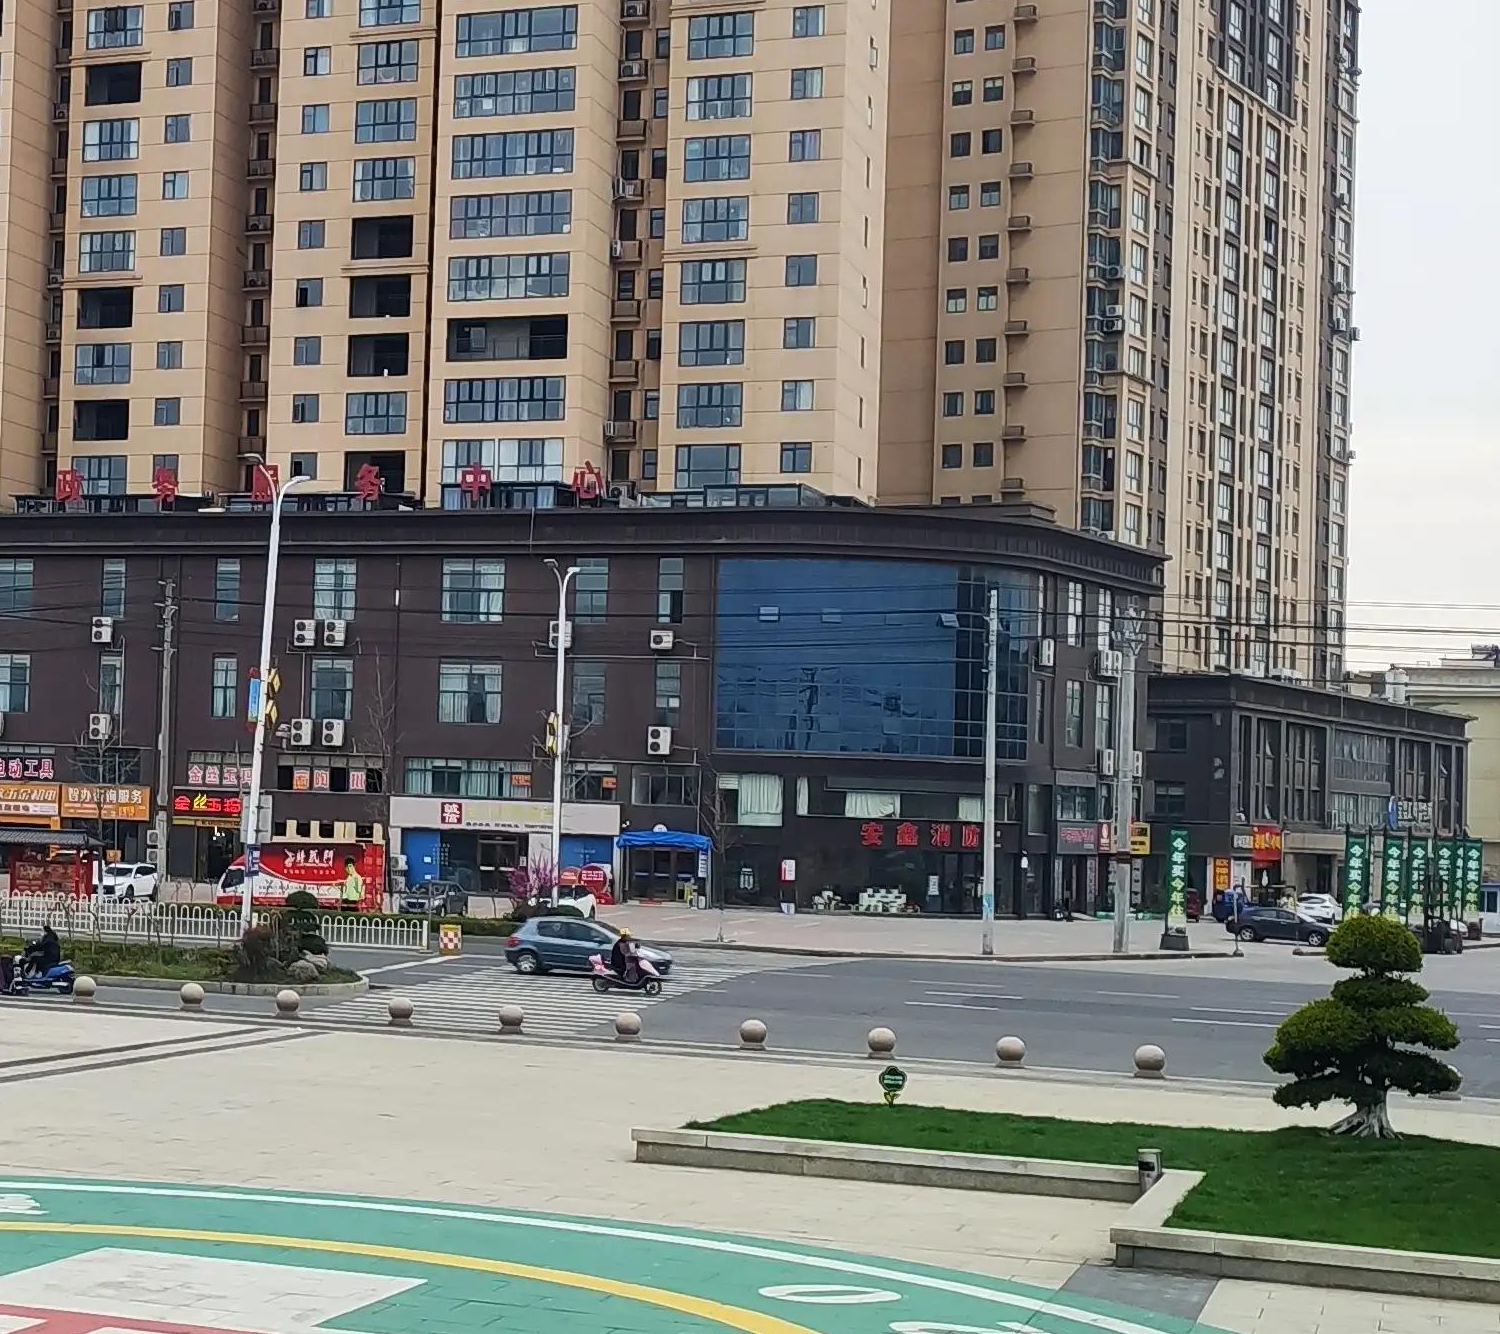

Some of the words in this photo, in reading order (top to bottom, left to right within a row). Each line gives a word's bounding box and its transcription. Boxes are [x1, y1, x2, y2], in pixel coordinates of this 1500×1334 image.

[860, 822, 981, 847] 安鑫消防
[1170, 837, 1188, 916] 今年买今年住
